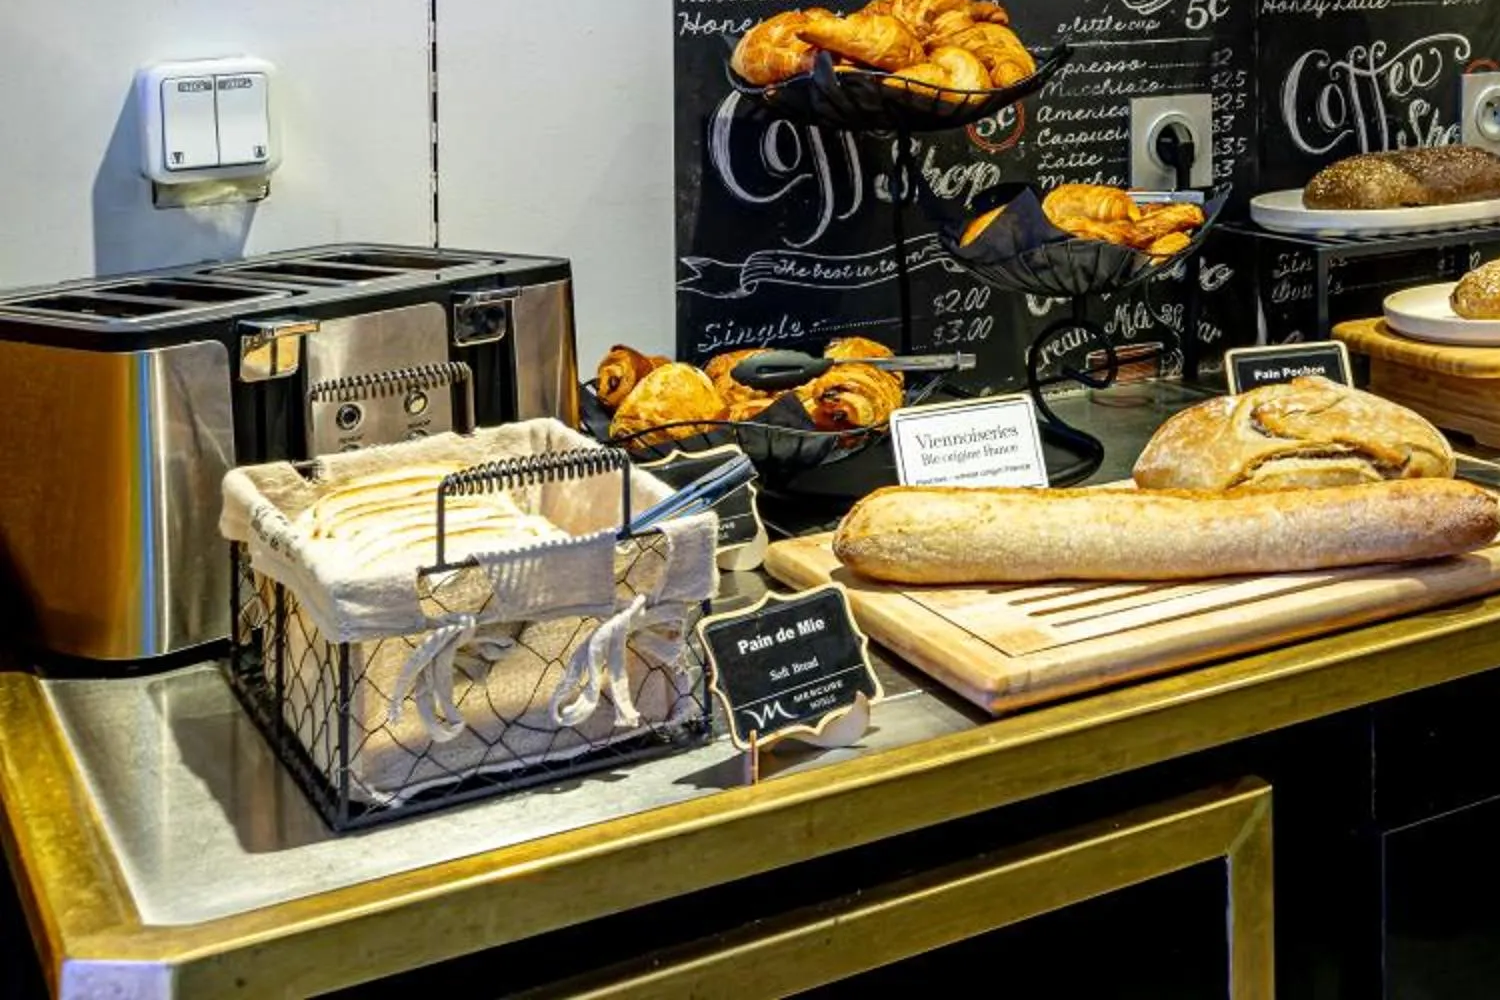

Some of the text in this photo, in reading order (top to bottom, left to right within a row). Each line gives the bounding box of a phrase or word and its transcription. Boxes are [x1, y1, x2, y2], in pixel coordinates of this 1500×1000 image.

[1254, 369, 1280, 380] Pain
[915, 424, 1019, 448] Viennoiseries
[983, 444, 1018, 457] France
[737, 618, 825, 655] Pain de Mie
